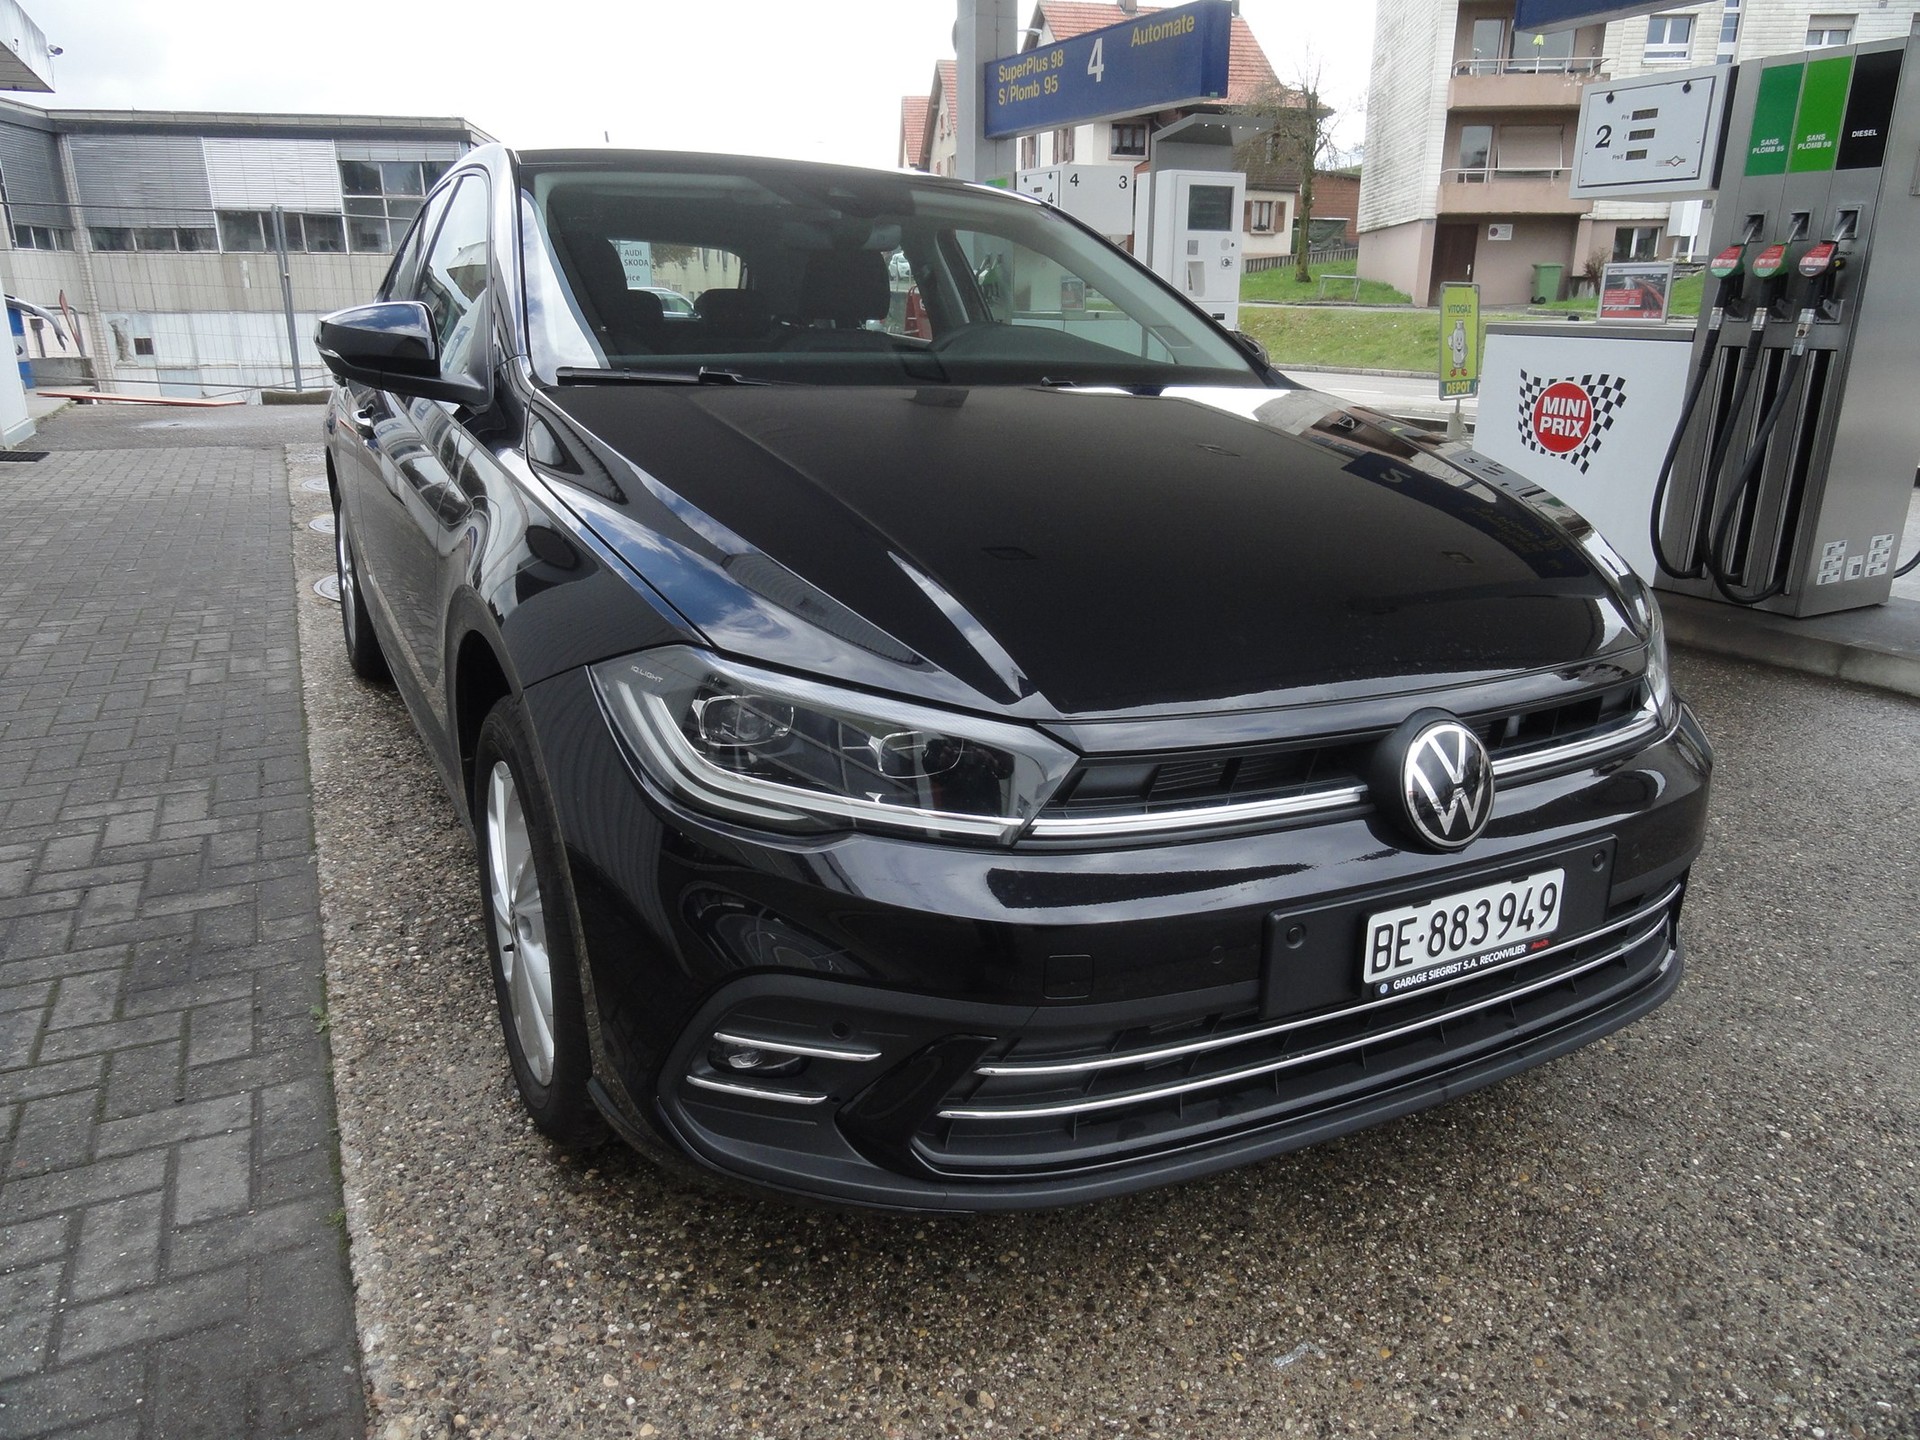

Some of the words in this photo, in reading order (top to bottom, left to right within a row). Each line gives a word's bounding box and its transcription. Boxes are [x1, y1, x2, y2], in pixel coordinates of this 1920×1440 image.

[1131, 14, 1195, 47] Automate
[998, 57, 1048, 84] SuperPlus
[1050, 49, 1064, 69] 98
[1087, 37, 1105, 83] 4
[998, 80, 1041, 106] S/Plomb
[1043, 74, 1059, 95] 95
[1594, 124, 1612, 149] 2
[1806, 133, 1826, 142] SANS
[1851, 129, 1878, 138] DIESEL
[1760, 138, 1779, 147] SANS
[1069, 173, 1080, 187] 4
[1118, 175, 1128, 189] 3
[1047, 192, 1054, 204] 4
[624, 249, 643, 257] AUDI
[623, 259, 649, 267] SKODA
[1447, 304, 1472, 314] VITOGAZ
[1446, 382, 1471, 395] DEPOT
[1542, 396, 1587, 418] MINI
[1539, 416, 1584, 438] PRIX
[1393, 971, 1428, 990] GARAGE
[1428, 962, 1462, 980] SIEGRIST
[1463, 959, 1478, 970] S.A.
[1479, 944, 1526, 966] RECONVILIER
